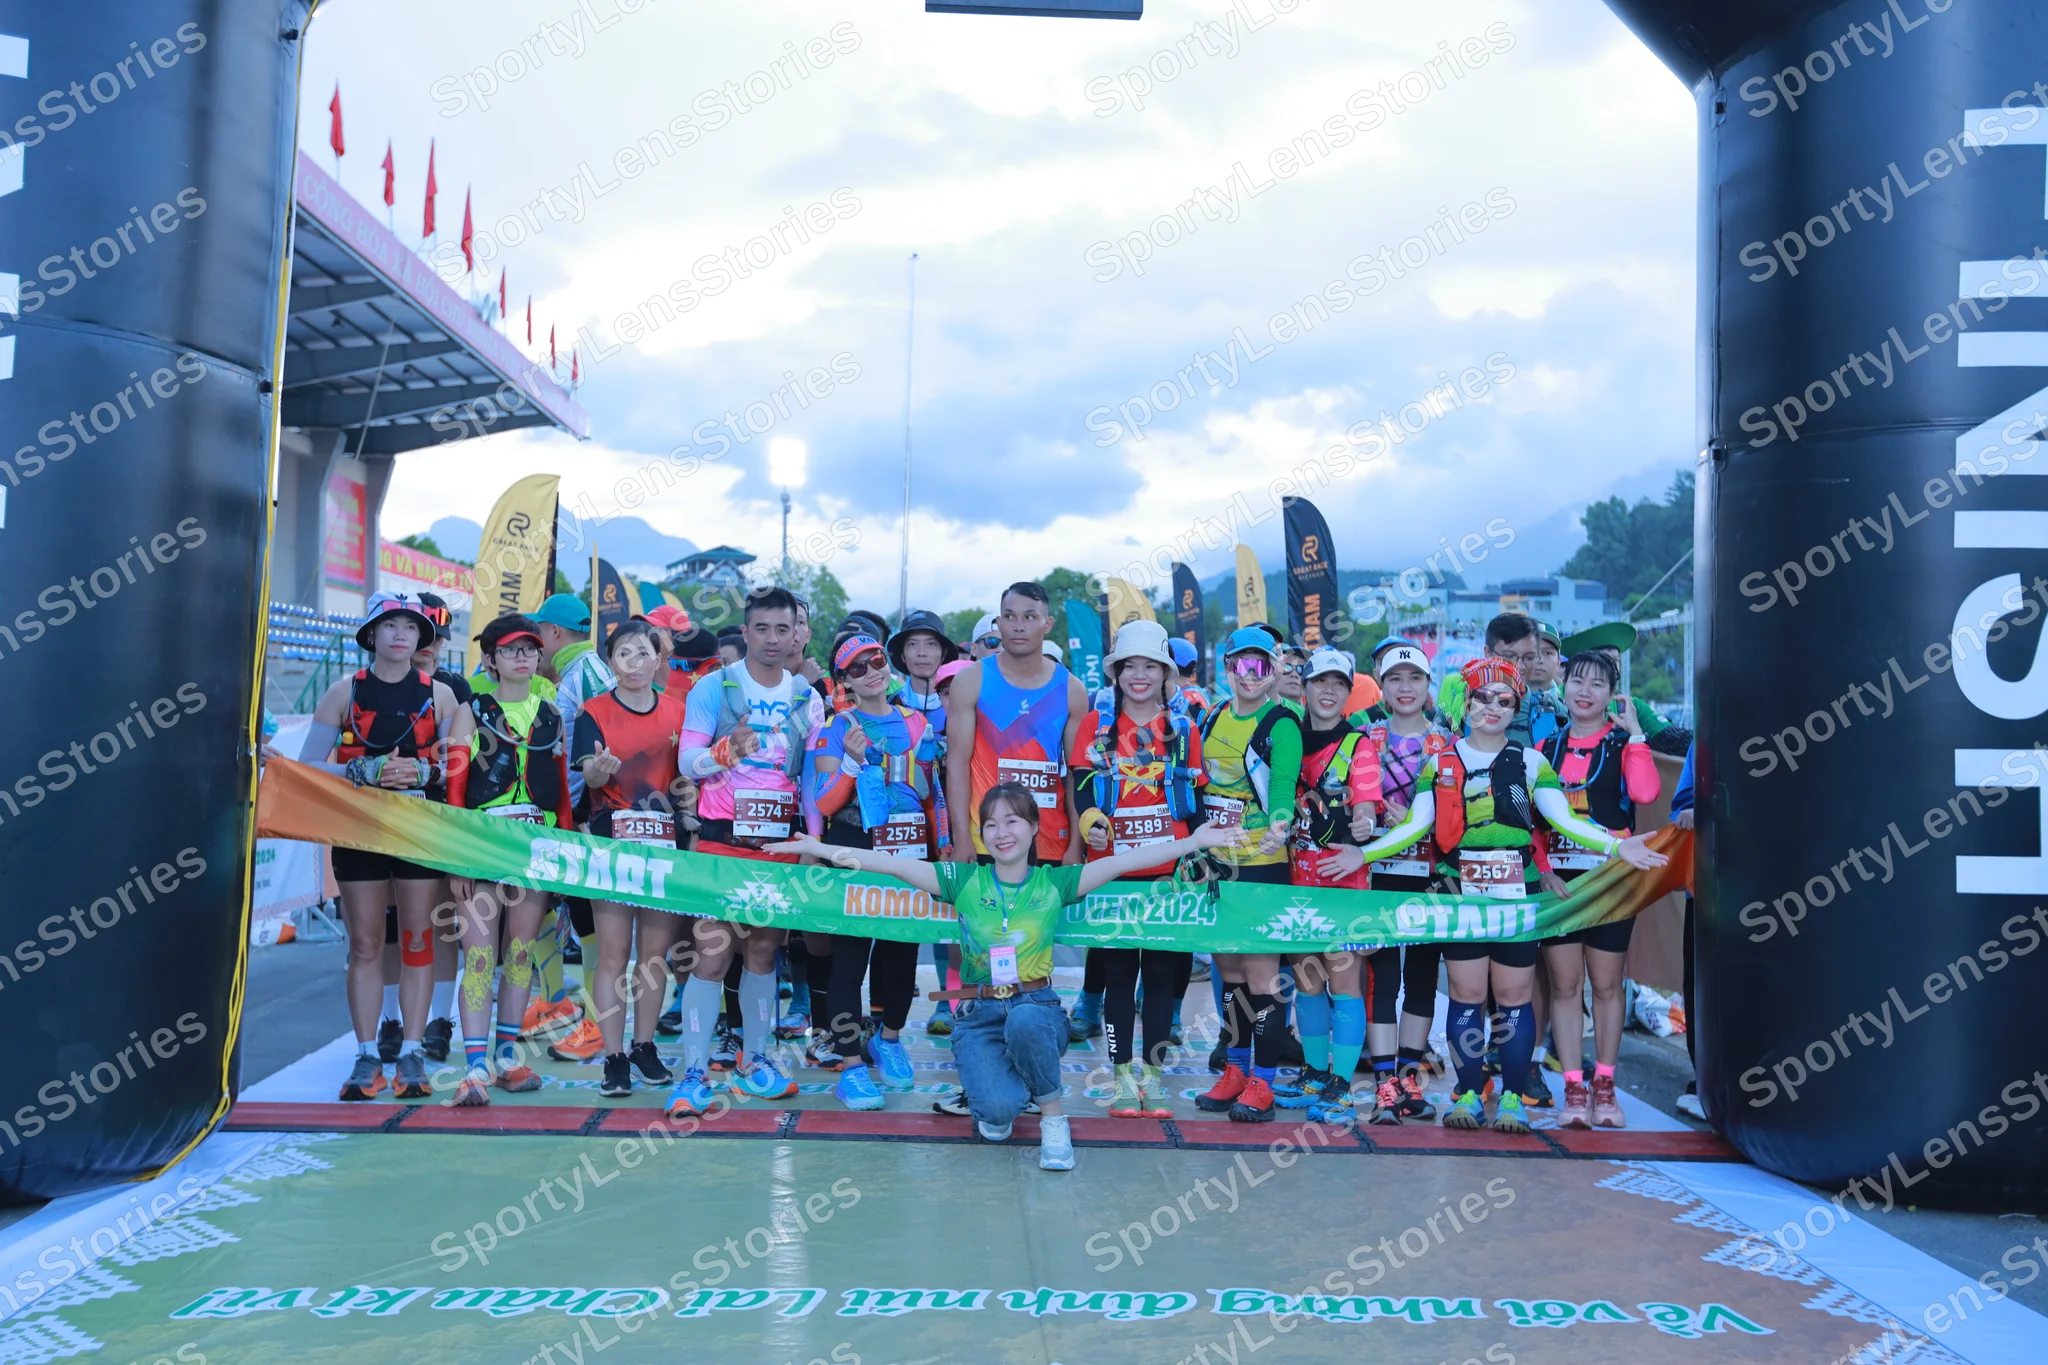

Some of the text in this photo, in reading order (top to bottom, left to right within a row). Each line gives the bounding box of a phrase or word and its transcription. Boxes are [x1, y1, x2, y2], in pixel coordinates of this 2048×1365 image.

[1011, 772, 1048, 788] 2506
[747, 802, 783, 818] 2574
[779, 794, 792, 802] 25KM
[1226, 802, 1242, 812] 25KM
[625, 820, 664, 836] 2558
[1124, 817, 1163, 835] 2589
[1205, 808, 1229, 825] 556
[886, 826, 918, 841] 2575
[1472, 864, 1511, 880] 2567
[1142, 891, 1218, 926] 2024
[1105, 1023, 1118, 1053] RUN
[428, 1286, 666, 1320] Châu
[675, 1286, 826, 1319] Lai
[834, 1286, 993, 1319] núi
[997, 1286, 1197, 1320] đỉnh
[1202, 1287, 1484, 1325] những
[1494, 1296, 1634, 1330] với
[1635, 1300, 1775, 1338] Về
